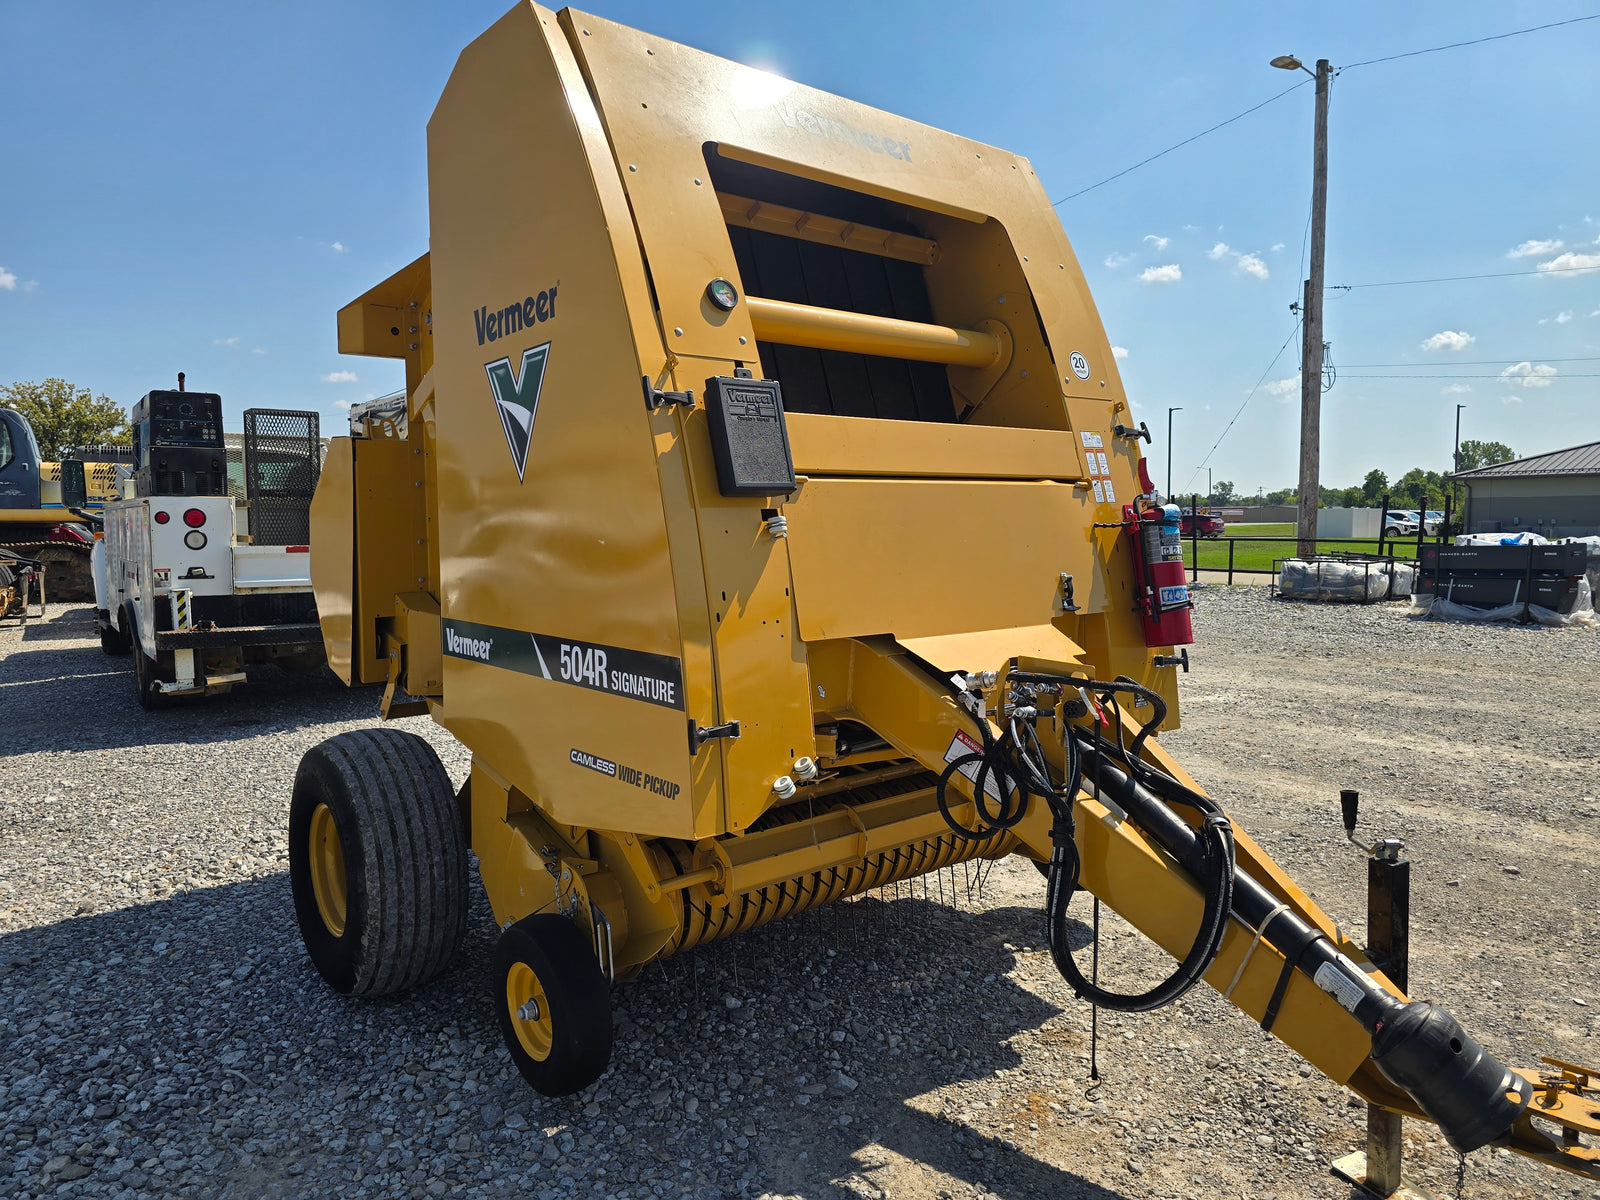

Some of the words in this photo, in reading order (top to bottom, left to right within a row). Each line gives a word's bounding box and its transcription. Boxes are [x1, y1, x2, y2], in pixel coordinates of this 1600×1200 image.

[473, 286, 558, 346] Vermeer
[1072, 356, 1085, 369] 20
[727, 389, 775, 405] Vermeer
[446, 628, 492, 660] Vermeer
[560, 643, 609, 689] 504R
[611, 670, 675, 704] SIGNATURE
[964, 738, 985, 756] DANGER
[570, 750, 616, 775] CAMLESS
[618, 764, 642, 789] WIDE
[643, 775, 681, 801] PICKUP
